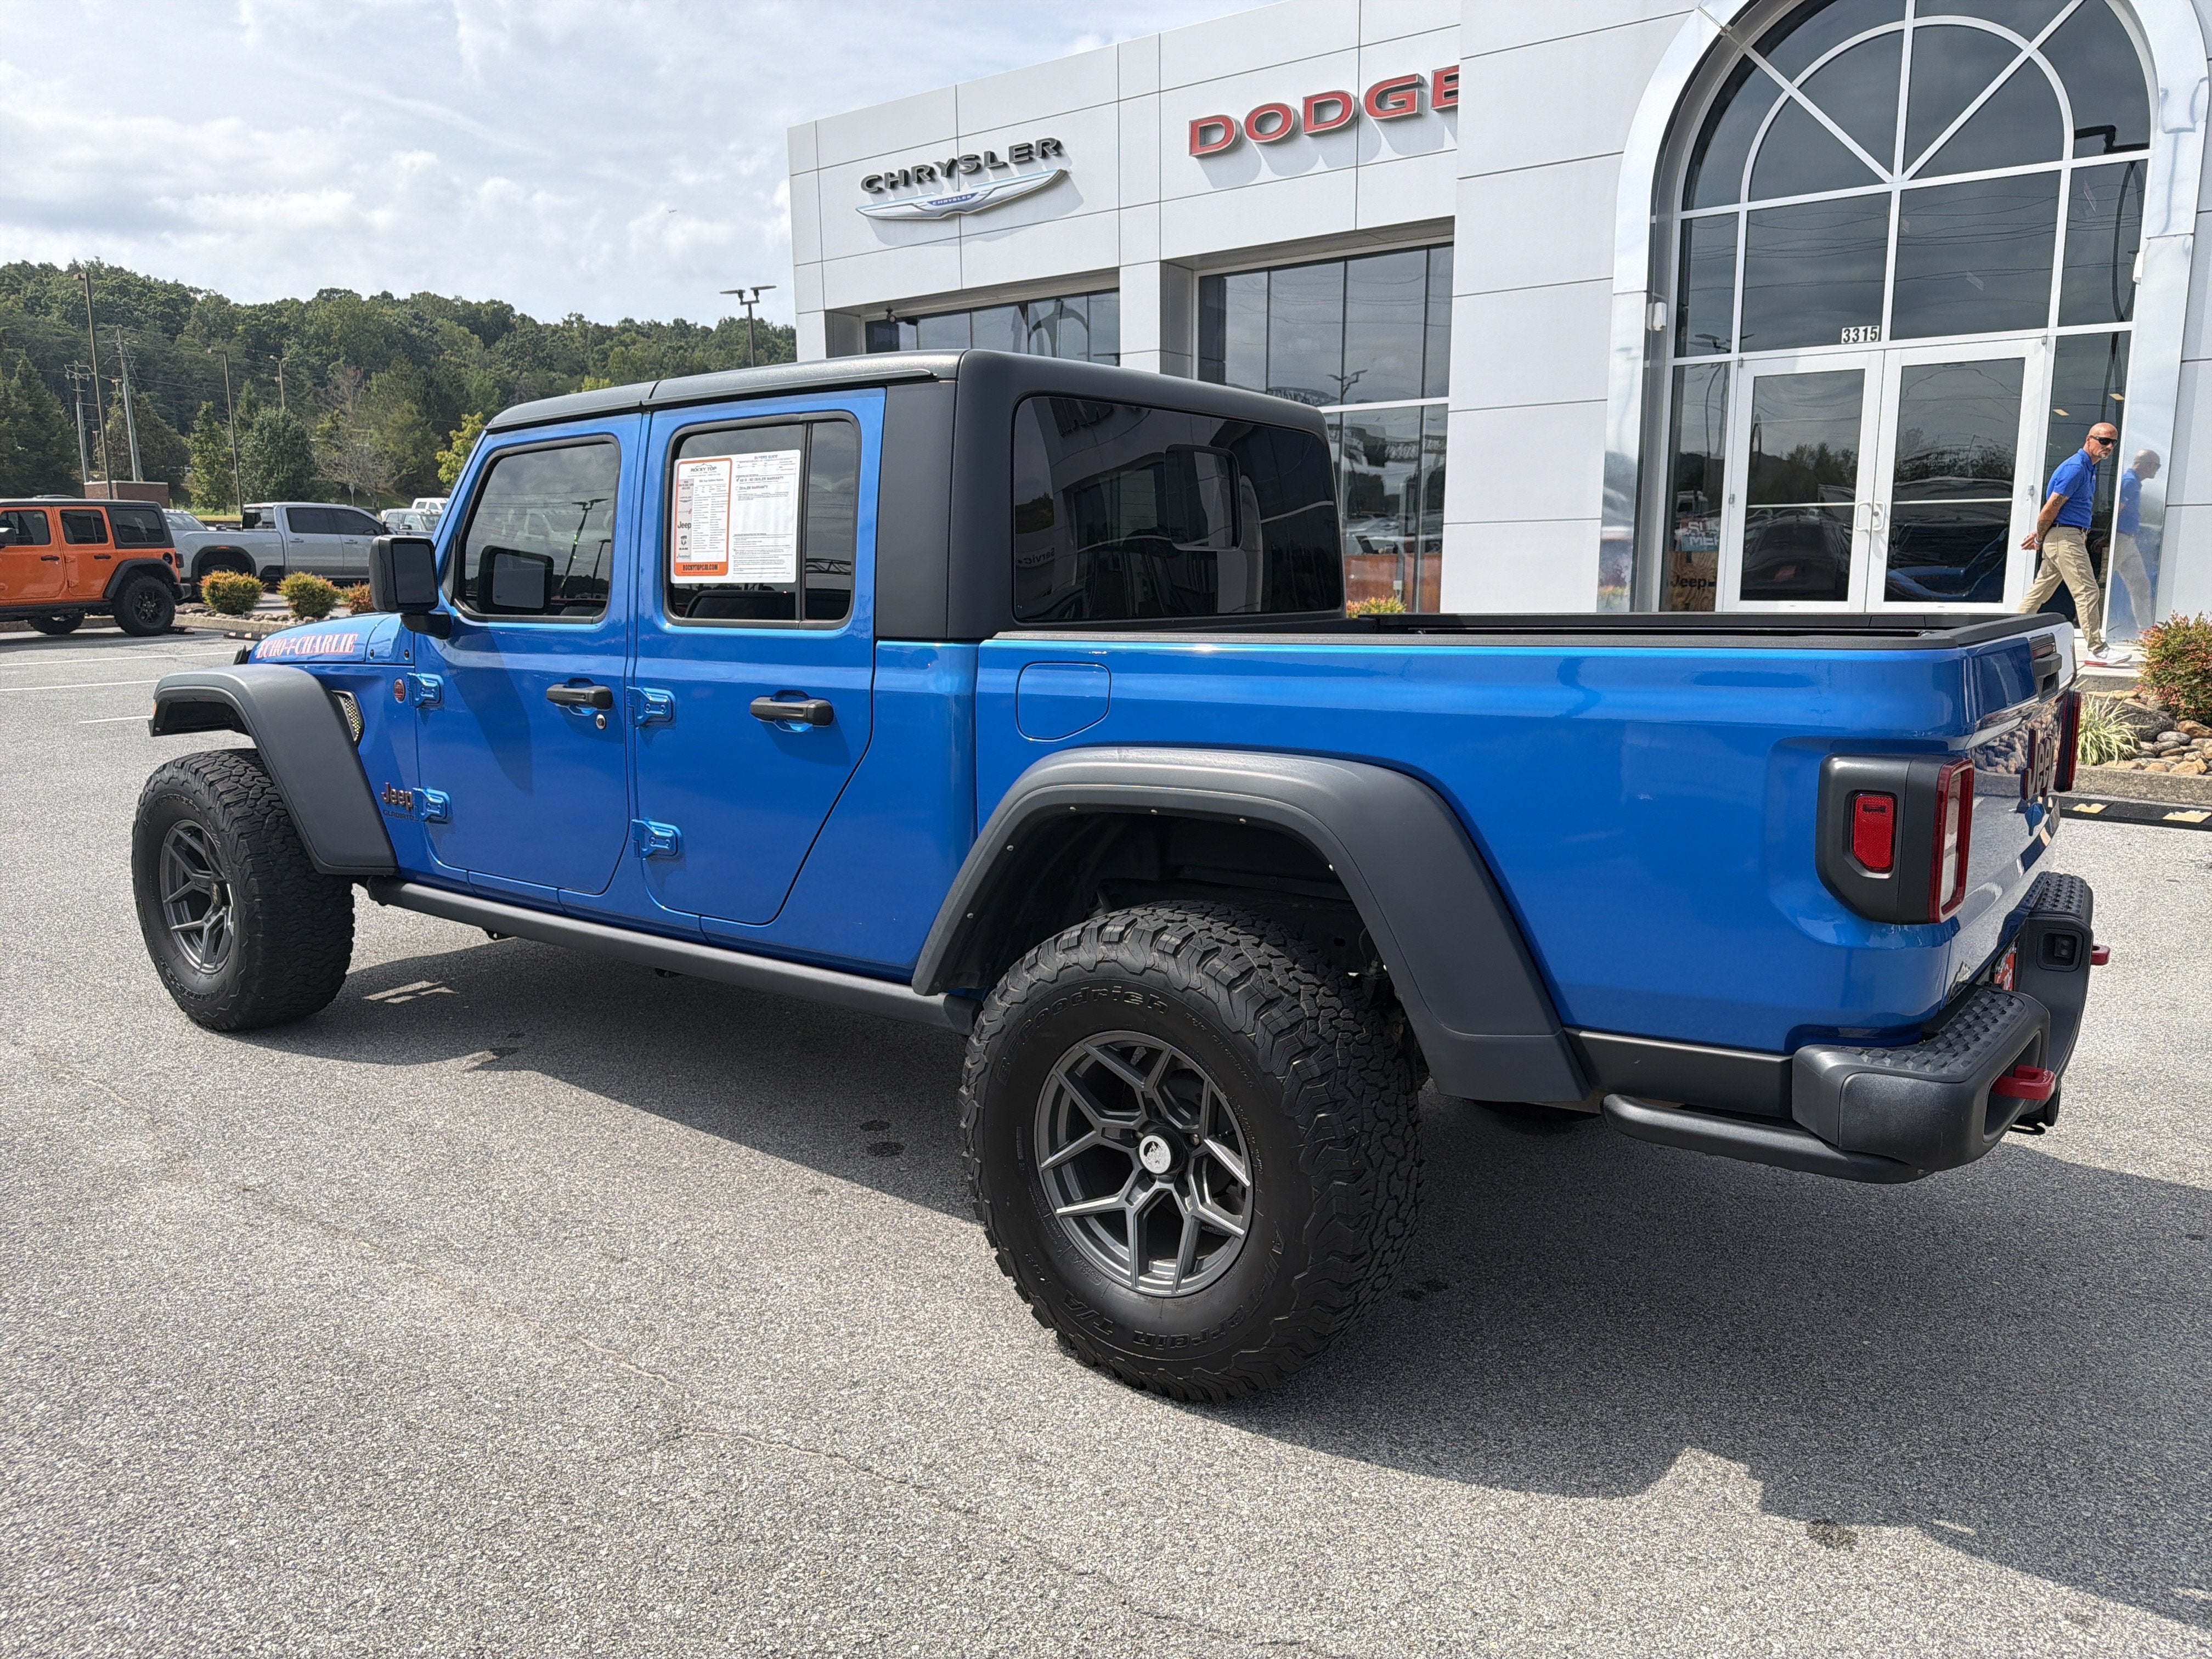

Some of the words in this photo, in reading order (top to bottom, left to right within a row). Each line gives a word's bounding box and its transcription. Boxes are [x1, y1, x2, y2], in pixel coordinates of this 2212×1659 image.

[1189, 64, 1460, 157] DODGE
[861, 137, 1063, 193] CHRYSLER
[1843, 326, 1878, 343] 3315
[678, 521, 692, 530] Jeep
[1670, 575, 1707, 590] Jeep
[381, 782, 414, 812] Jeep
